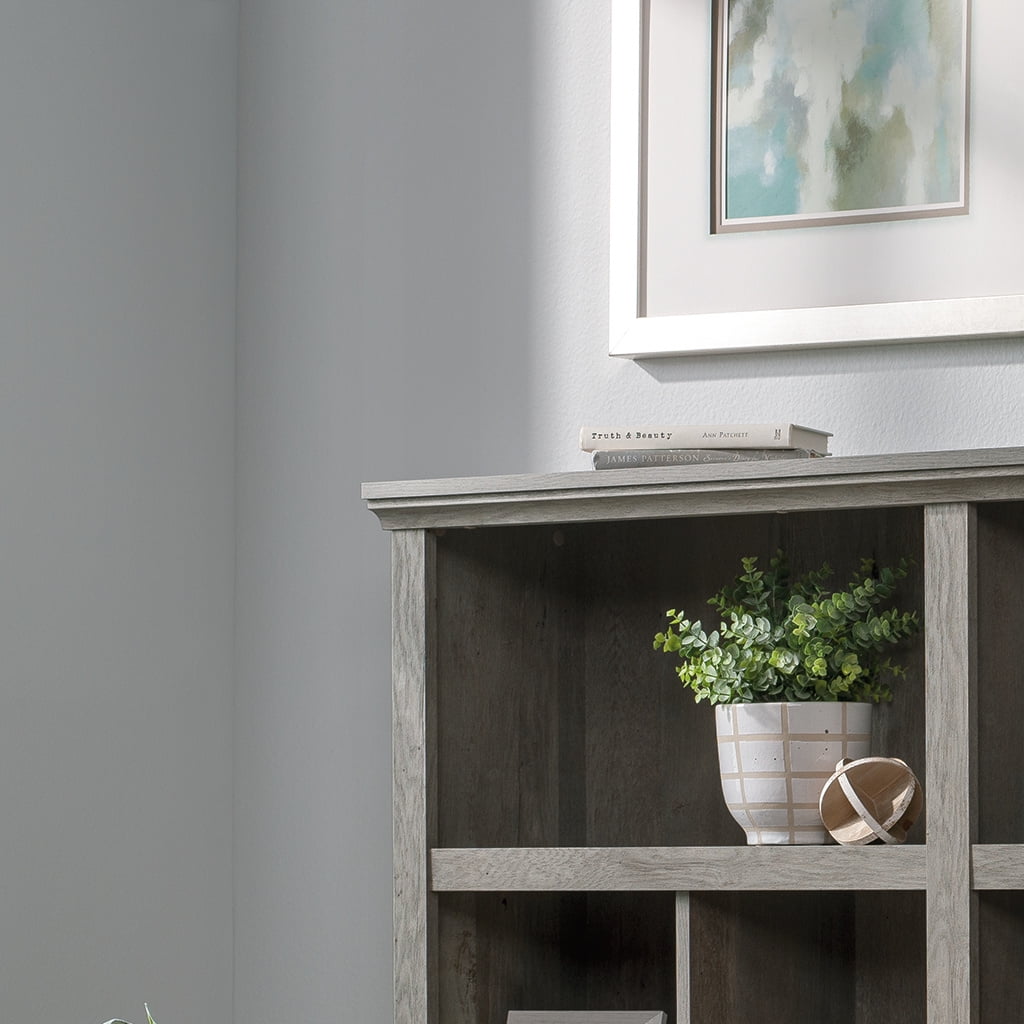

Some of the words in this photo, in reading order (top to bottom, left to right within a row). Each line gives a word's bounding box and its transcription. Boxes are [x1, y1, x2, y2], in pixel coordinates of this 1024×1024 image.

[592, 432, 621, 440] Truth
[636, 431, 673, 440] Beauty
[606, 454, 639, 464] JAMES
[641, 454, 700, 463] PATTERSON
